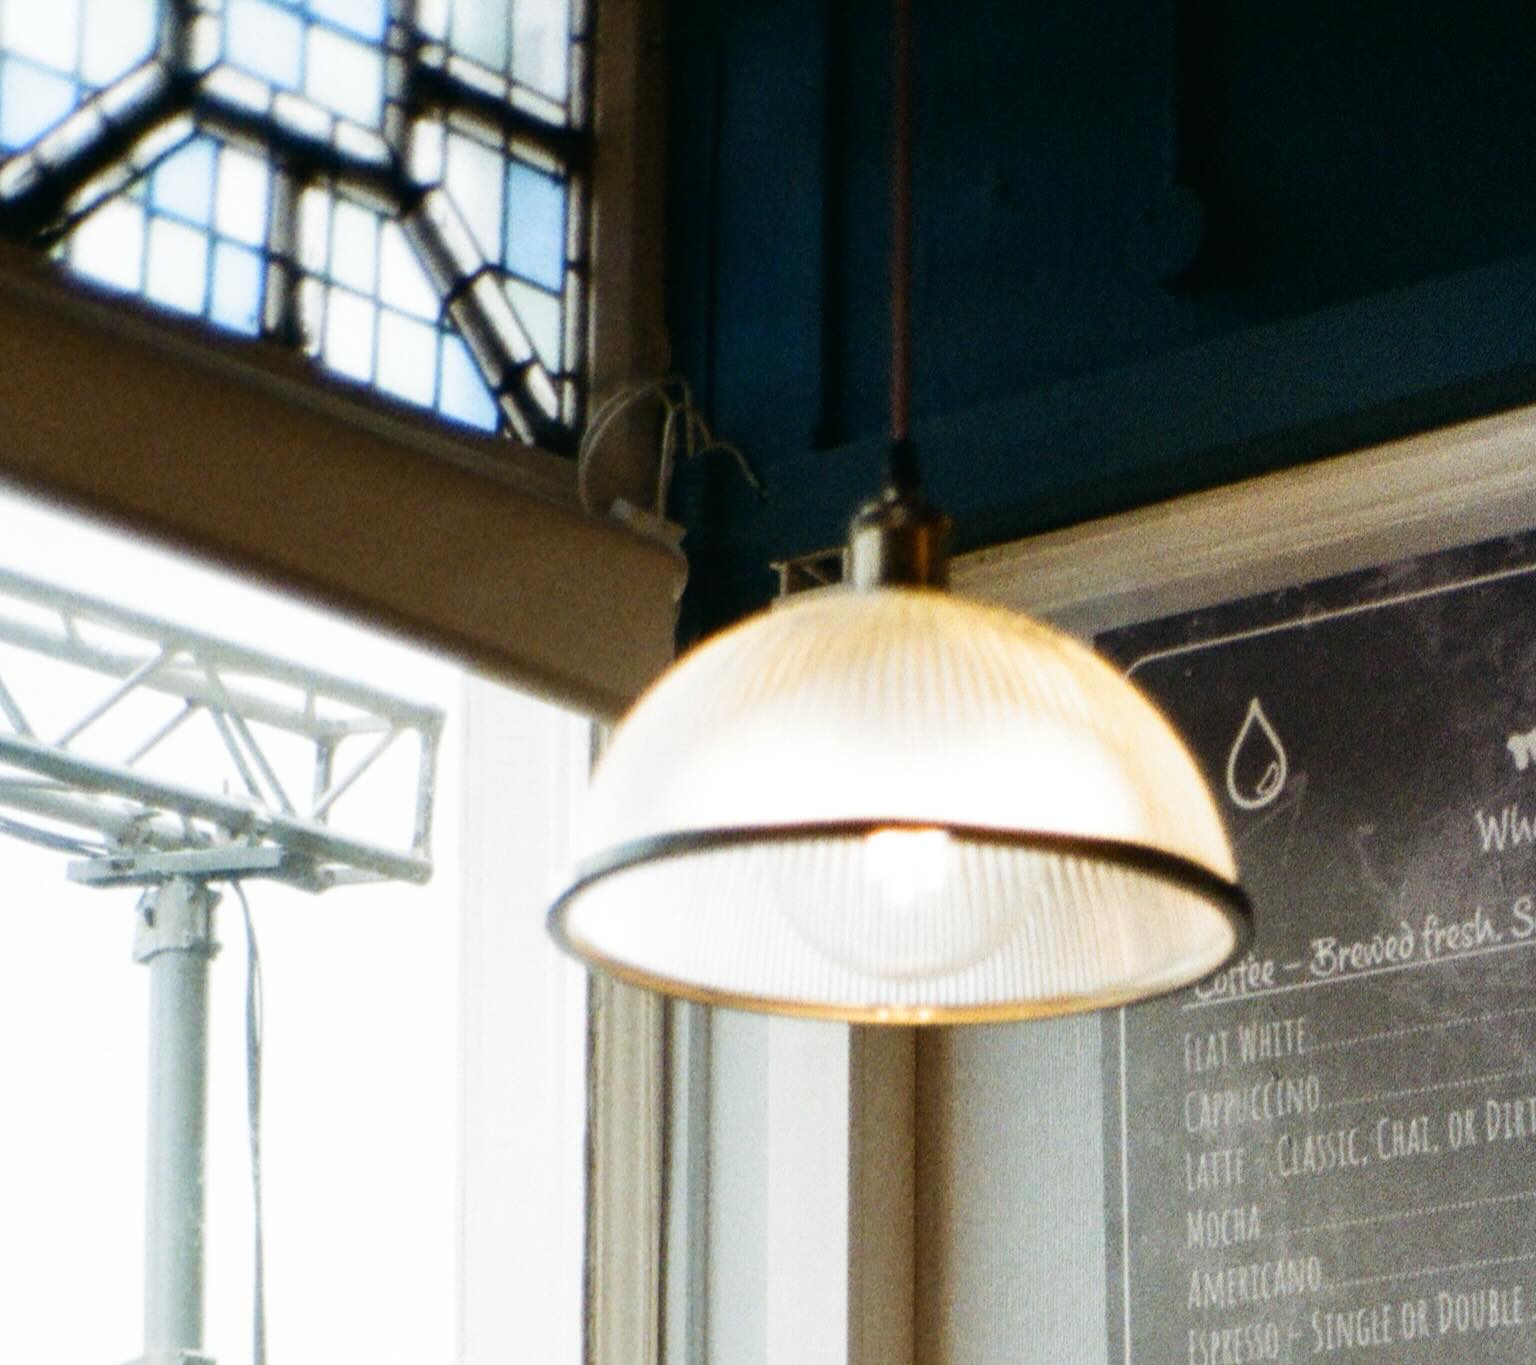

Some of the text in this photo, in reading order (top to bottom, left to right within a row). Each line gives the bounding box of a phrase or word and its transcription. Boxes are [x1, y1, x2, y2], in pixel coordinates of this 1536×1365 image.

[1310, 926, 1414, 978] Brewed
[1183, 1031, 1232, 1071] FLAT
[1239, 1016, 1307, 1060] WHITE
[1183, 1075, 1320, 1134] CAPPUCCINO
[1185, 1148, 1245, 1191] LATTE
[1448, 1110, 1477, 1150] OR
[1186, 1204, 1260, 1250] MOCHA
[1188, 1256, 1322, 1310] AMERICANO
[1310, 1304, 1392, 1354] SINGLE
[1402, 1299, 1431, 1341] OR
[1438, 1285, 1523, 1335] DOUBLE
